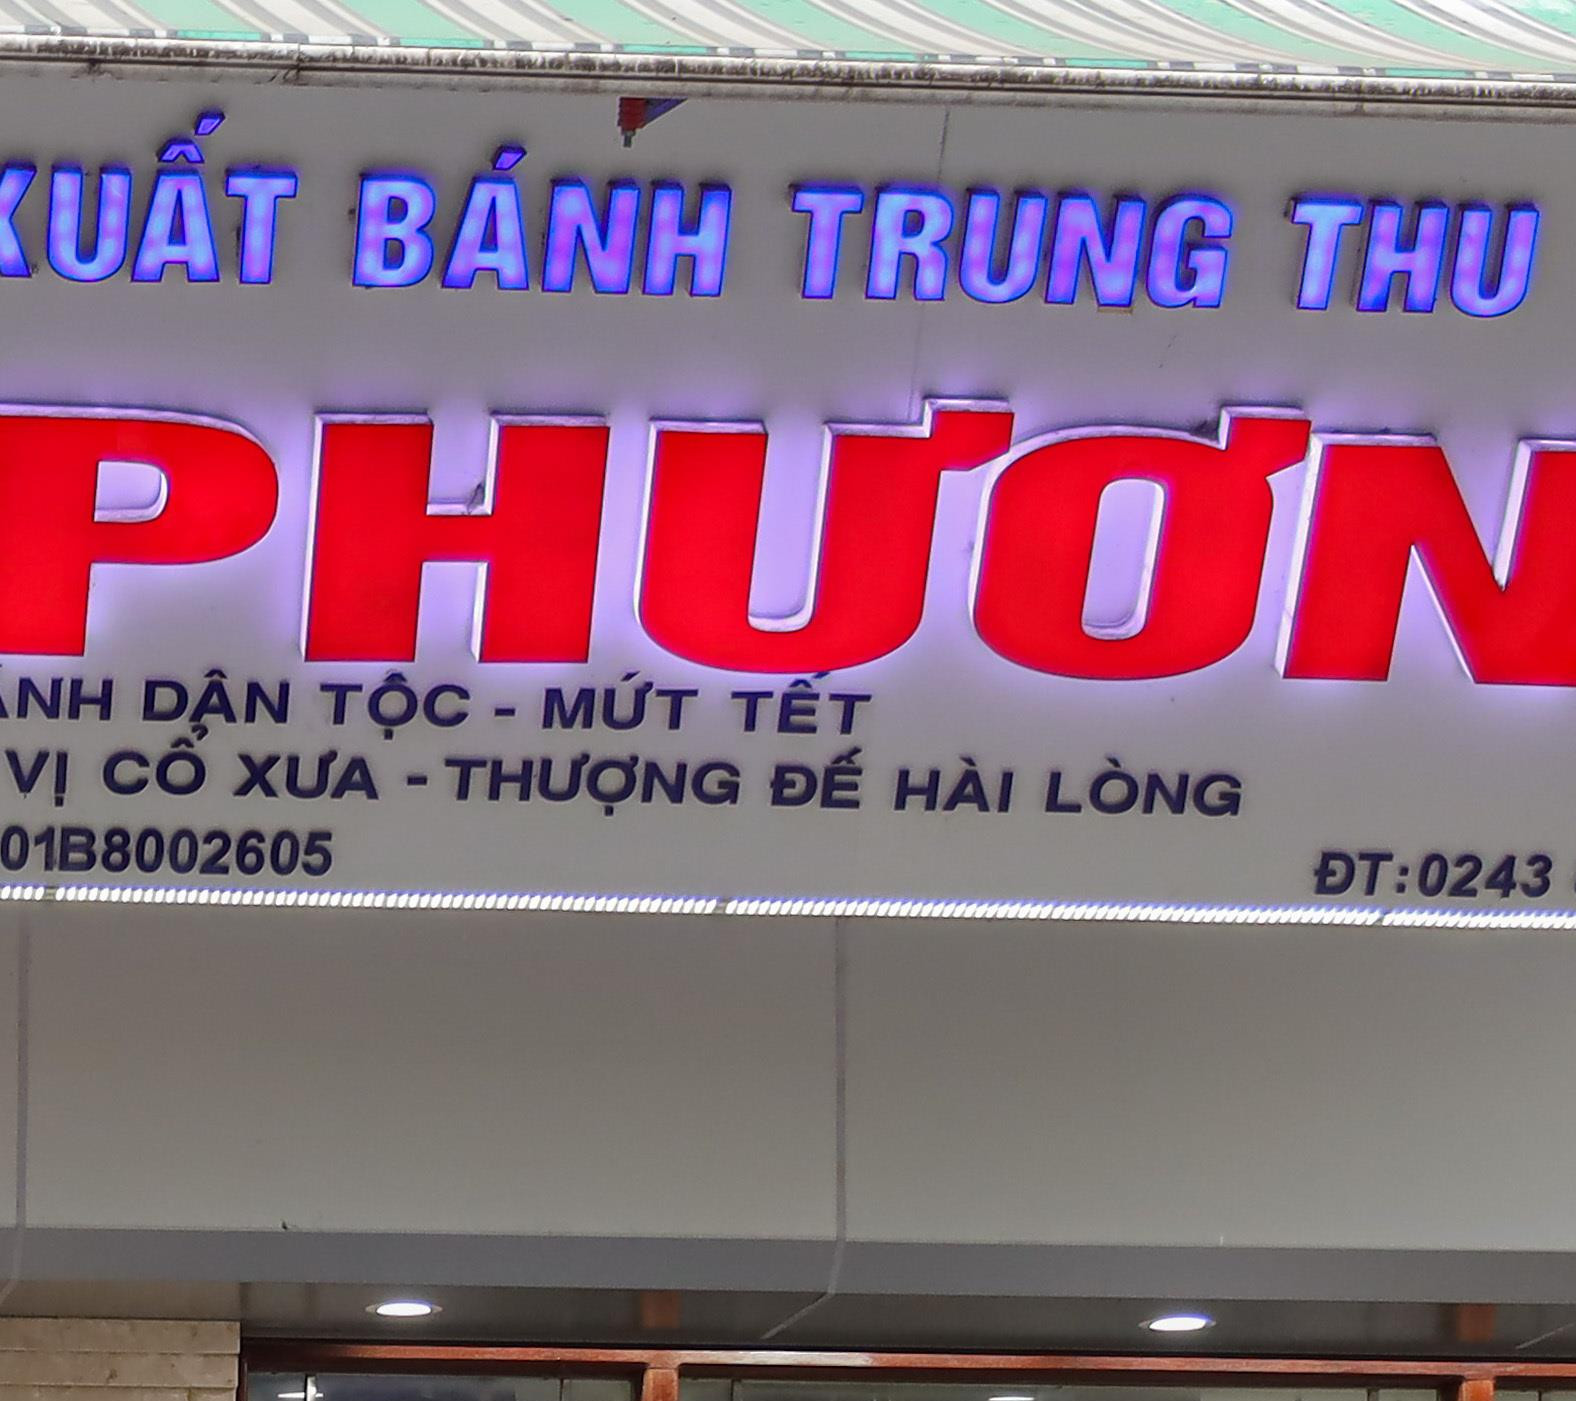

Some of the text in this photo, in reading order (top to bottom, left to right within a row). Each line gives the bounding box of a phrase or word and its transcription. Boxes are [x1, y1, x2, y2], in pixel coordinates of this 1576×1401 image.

[352, 147, 732, 296] BÁNH
[790, 184, 1234, 308] TRUNG
[1287, 195, 1539, 317] THU
[141, 667, 291, 725] DÂN
[318, 672, 472, 742] TỘC
[540, 670, 699, 732] MỨT
[730, 671, 873, 737] TẾT
[3, 747, 70, 809] VỊ
[101, 722, 210, 797] CỔ
[231, 747, 381, 802] XƯA
[442, 750, 742, 818] THƯỢNG
[768, 744, 865, 811] ĐẾ
[892, 755, 1015, 815] HÀI
[1043, 755, 1244, 818] LÒNG
[1311, 849, 1554, 900] ĐT:0243
